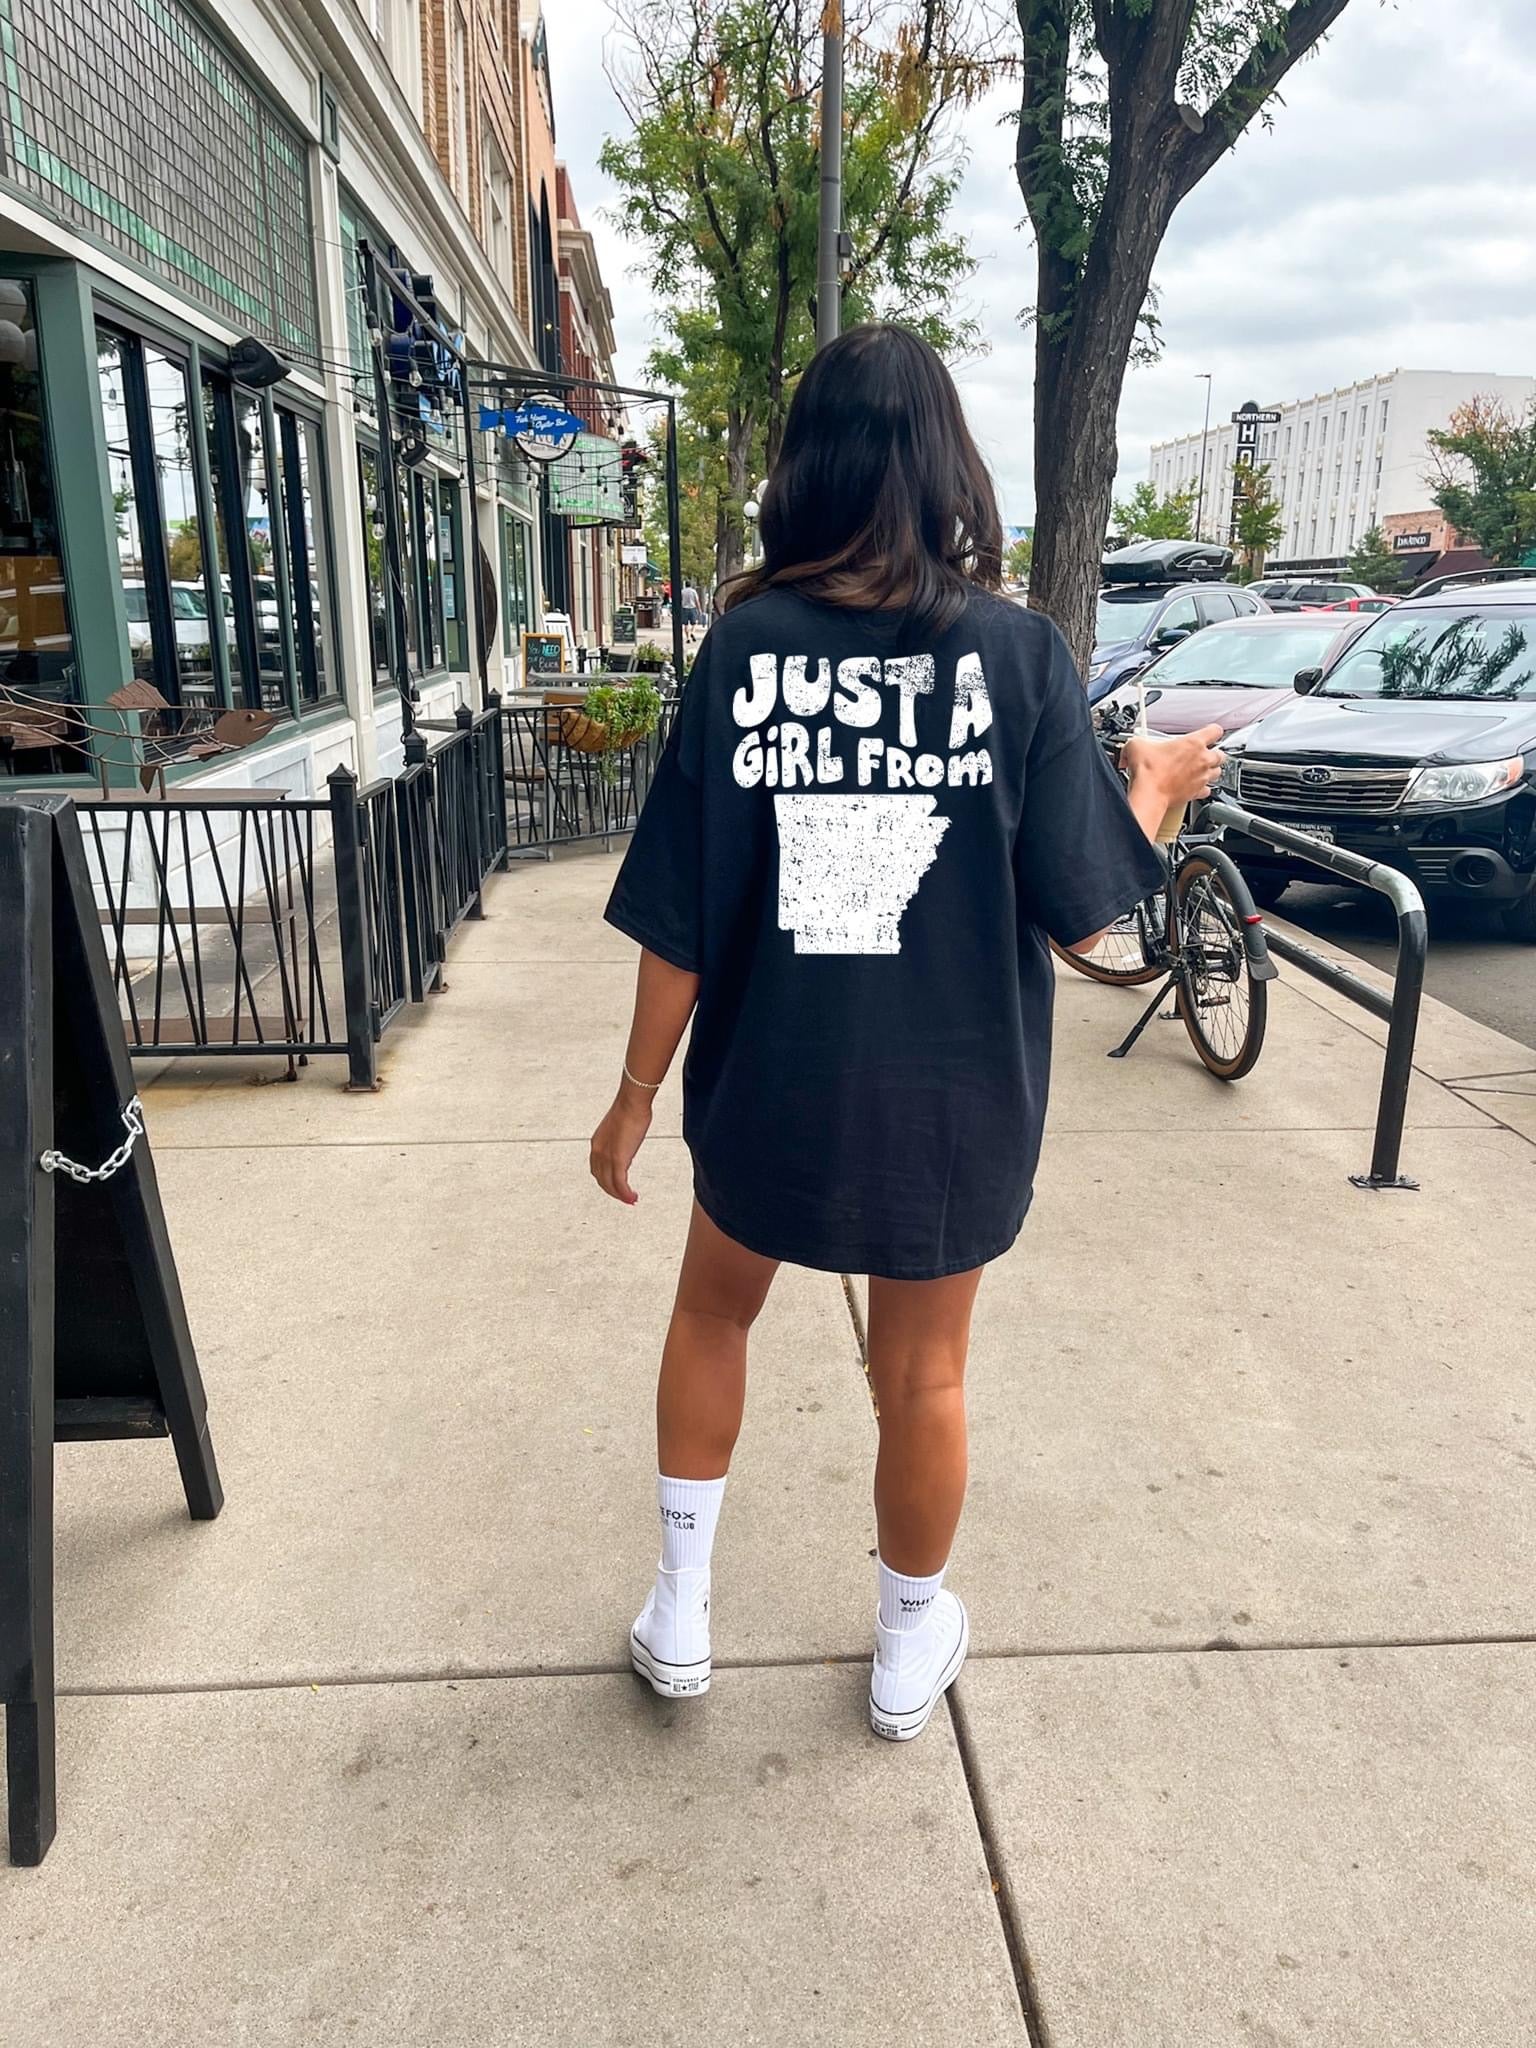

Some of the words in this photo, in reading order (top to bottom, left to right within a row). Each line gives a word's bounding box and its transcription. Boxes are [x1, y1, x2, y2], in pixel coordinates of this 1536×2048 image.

[1237, 413, 1277, 422] NORTHERN
[733, 653, 935, 748] JUST
[948, 651, 993, 749] A
